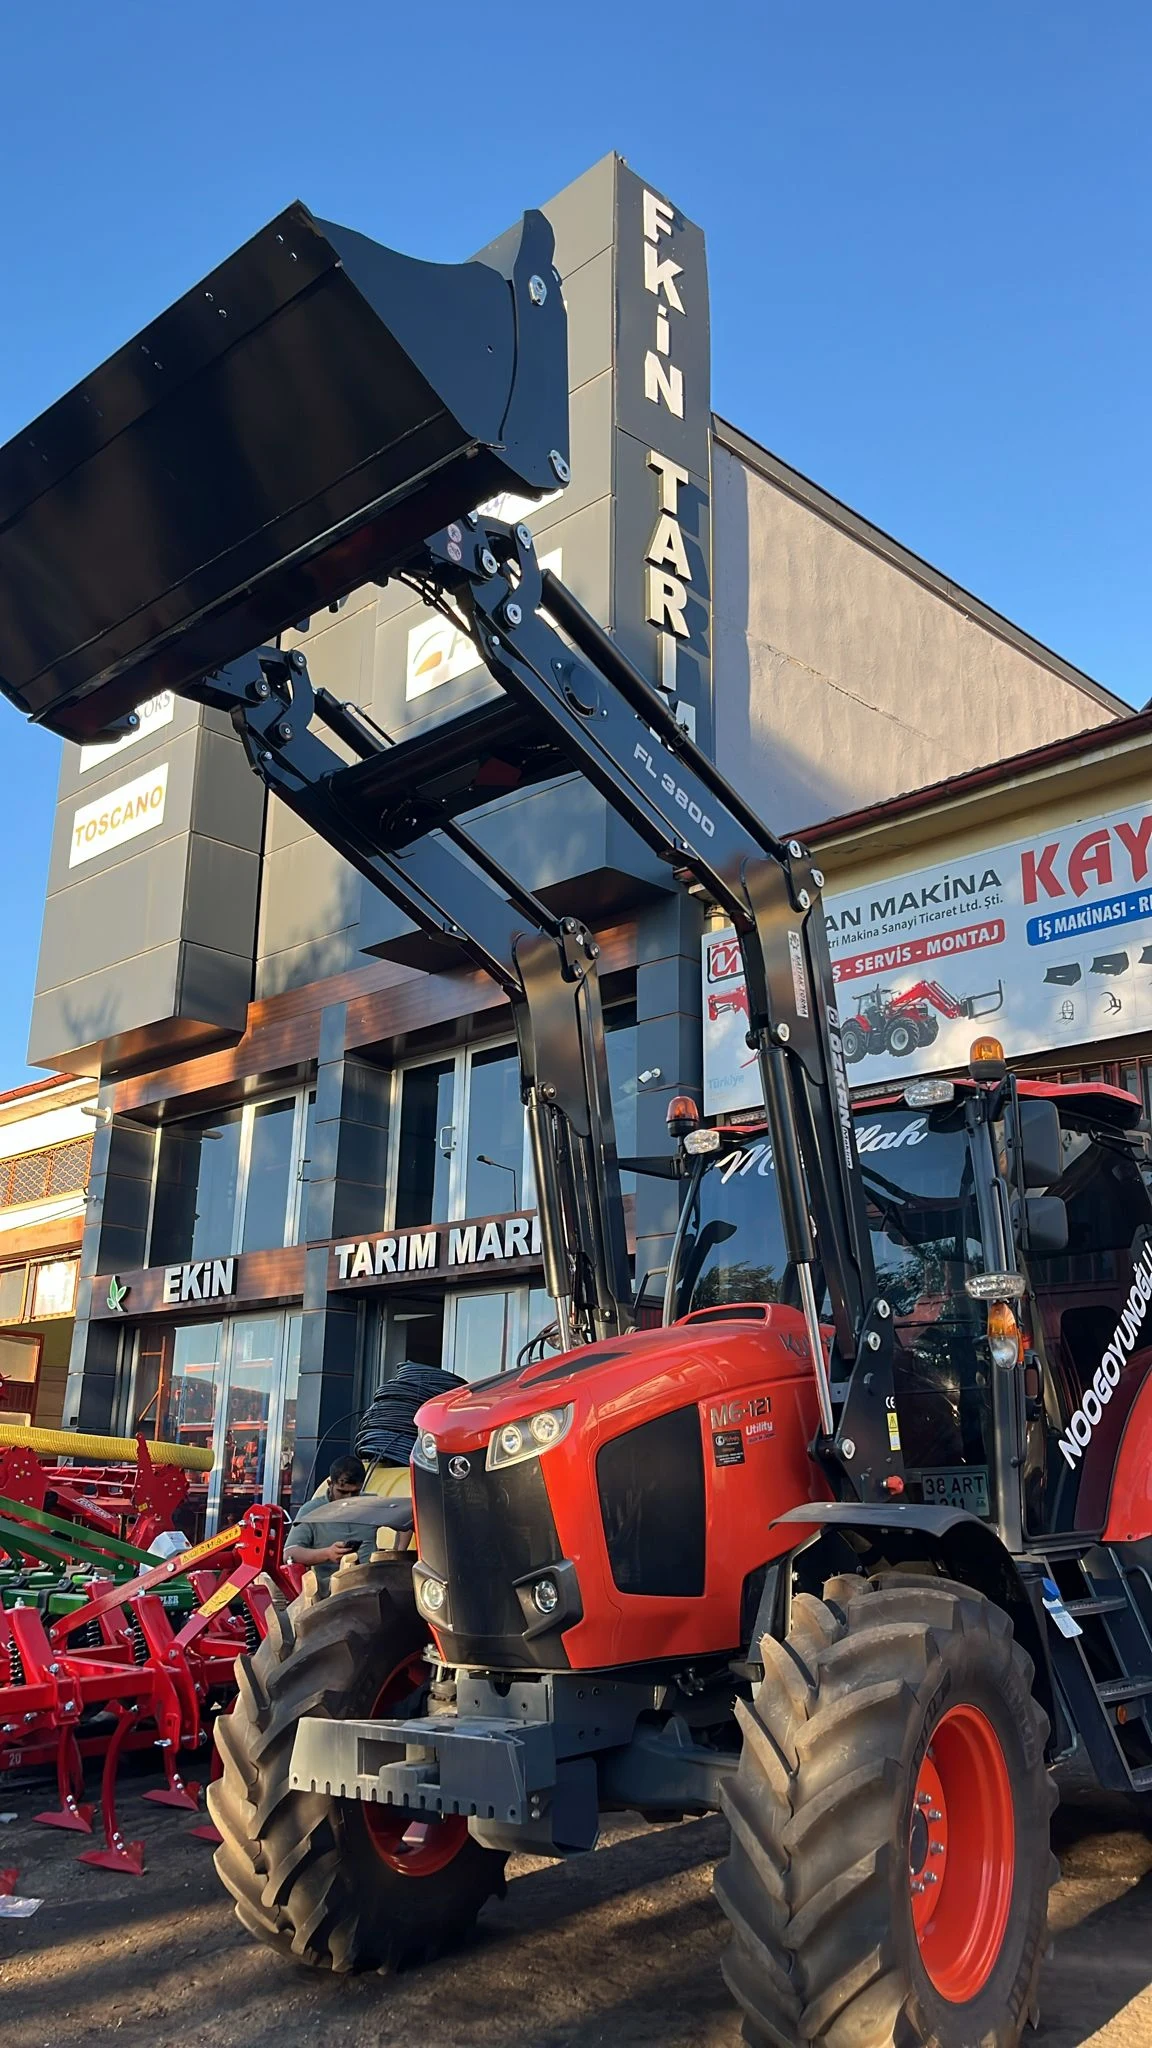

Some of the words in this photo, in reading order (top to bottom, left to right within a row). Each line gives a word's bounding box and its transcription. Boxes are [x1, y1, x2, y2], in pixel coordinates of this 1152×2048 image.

[633, 743, 657, 778] FL
[661, 773, 715, 838] 3800
[75, 785, 163, 847] TOSCANO
[870, 869, 1002, 921] MAKİNA
[841, 928, 879, 945] Makina
[882, 916, 917, 935] Sanayi
[919, 907, 957, 924] Ticaret
[960, 900, 982, 913] Ltd.
[984, 895, 1003, 910] Şti.
[1038, 920, 1052, 940] İŞ
[1054, 901, 1126, 934] MAKİNASI
[855, 946, 911, 974] SERVİS
[926, 924, 999, 956] MONTAJ
[335, 1232, 438, 1279] TARIM
[711, 1396, 771, 1430] M6-121
[746, 1421, 773, 1436] Utility
[926, 1478, 946, 1495] 38
[951, 1476, 984, 1494] ART
